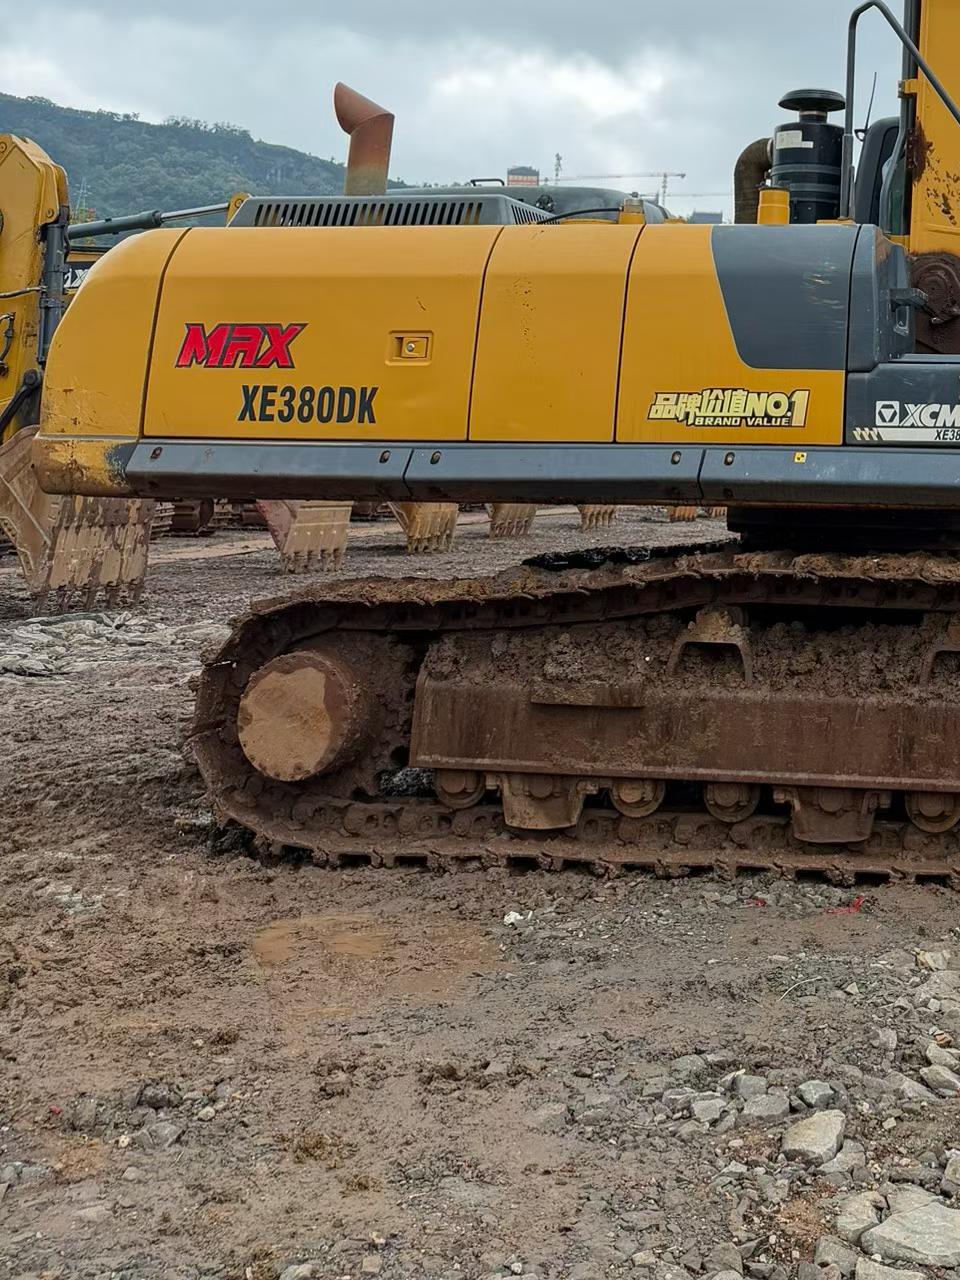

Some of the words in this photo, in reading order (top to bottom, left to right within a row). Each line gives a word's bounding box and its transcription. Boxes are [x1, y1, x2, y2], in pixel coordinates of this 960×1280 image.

[175, 323, 308, 368] MAX
[237, 385, 379, 424] XE380DK
[695, 417, 741, 426] BRAND
[747, 417, 790, 426] VALUE
